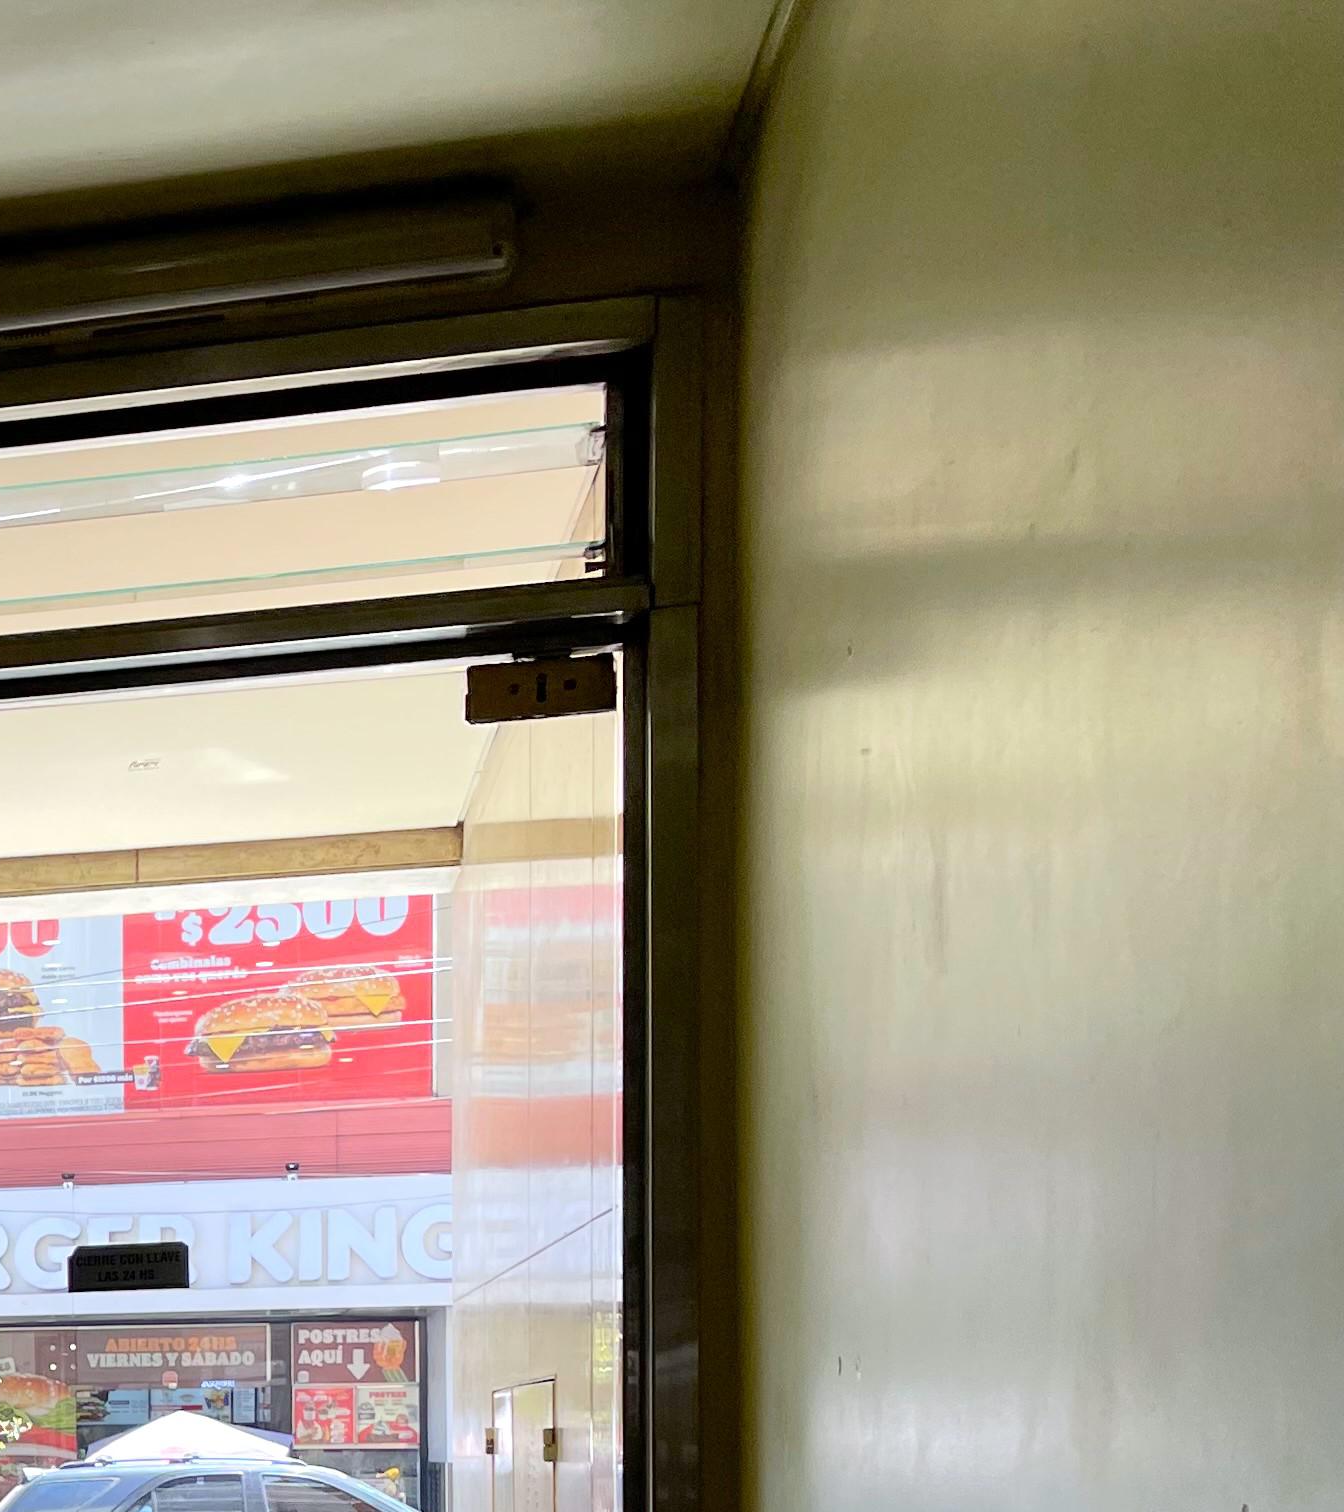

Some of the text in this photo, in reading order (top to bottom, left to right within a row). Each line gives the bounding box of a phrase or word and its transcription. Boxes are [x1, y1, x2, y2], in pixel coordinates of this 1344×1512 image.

[230, 1202, 453, 1285] KING
[76, 1250, 182, 1267] CIERRE CON LLAVE
[97, 1271, 119, 1282] LAS
[122, 1270, 136, 1281] 24
[105, 1336, 185, 1352] ABIERTO
[297, 1327, 381, 1344] POSTRES
[87, 1348, 256, 1368] VIERNES Y SÁBADO
[297, 1344, 343, 1367] AQUÍ
